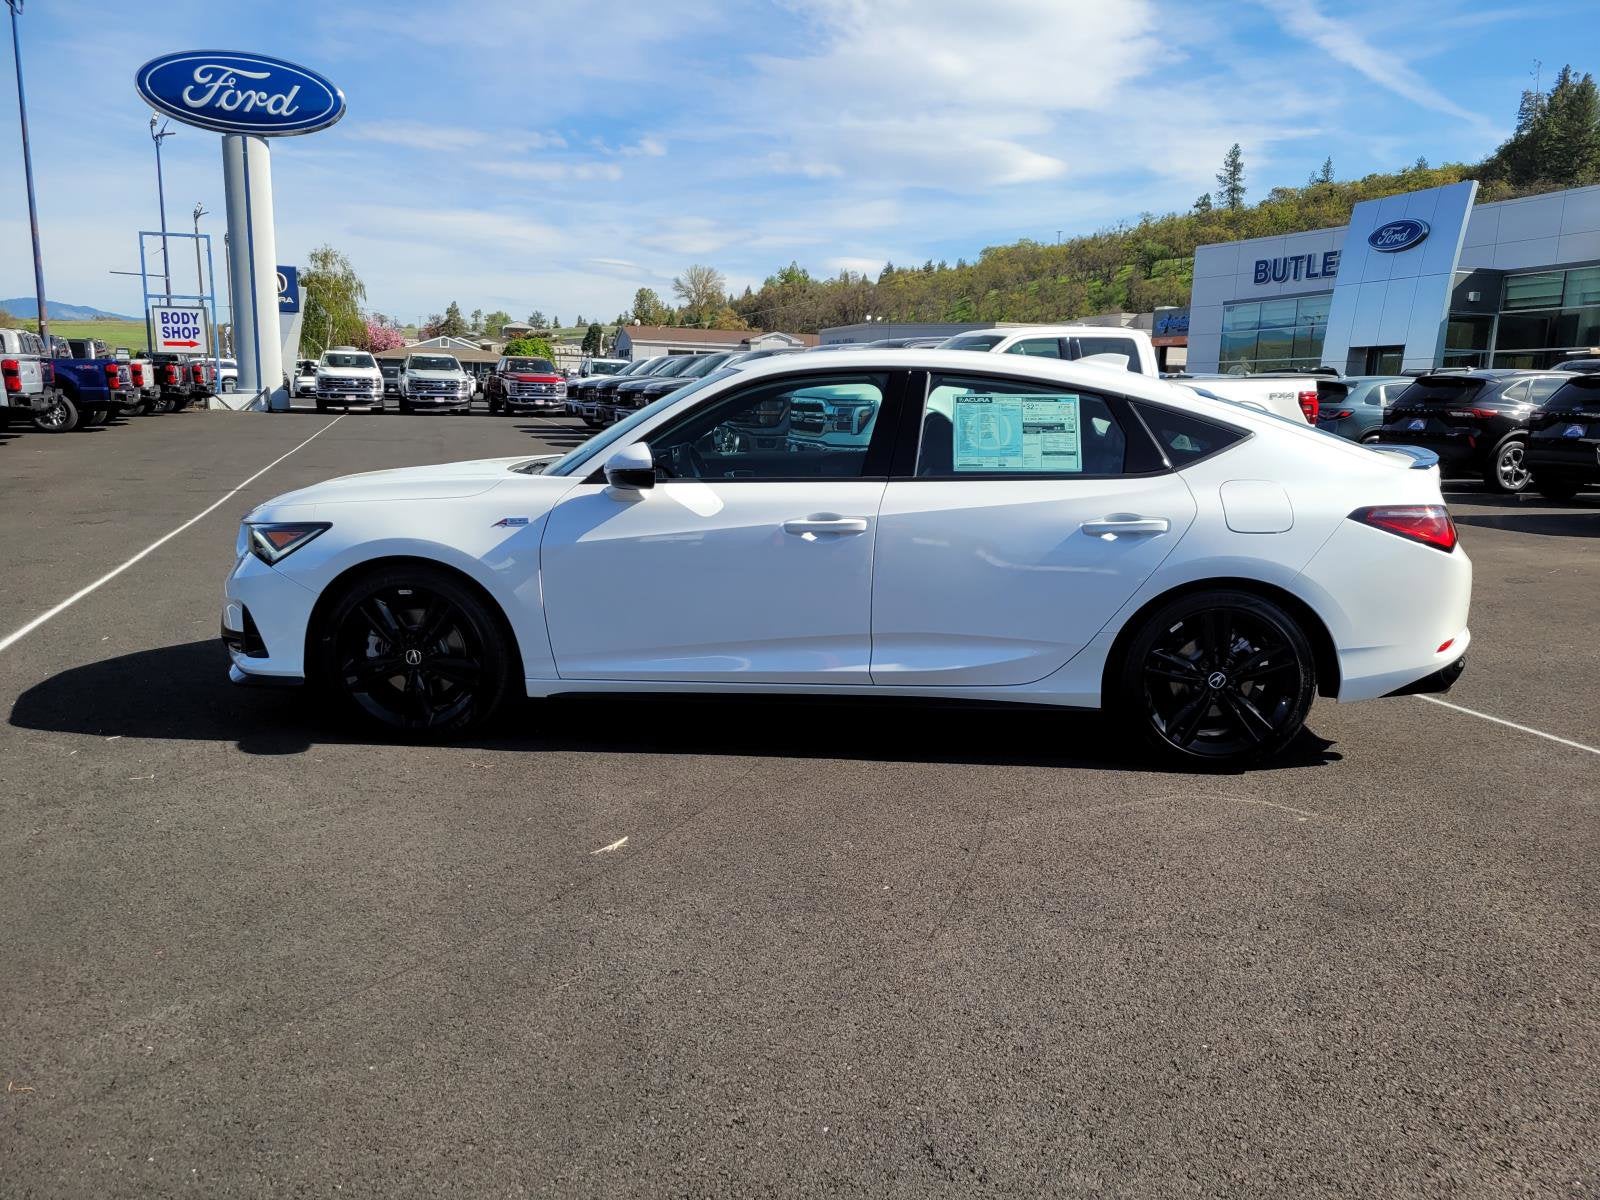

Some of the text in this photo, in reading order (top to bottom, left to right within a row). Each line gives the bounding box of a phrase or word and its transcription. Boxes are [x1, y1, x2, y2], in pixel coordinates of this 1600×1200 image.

[182, 64, 300, 117] Ford
[1377, 226, 1410, 245] Ford
[161, 311, 199, 325] BODY
[162, 326, 201, 339] SHOP
